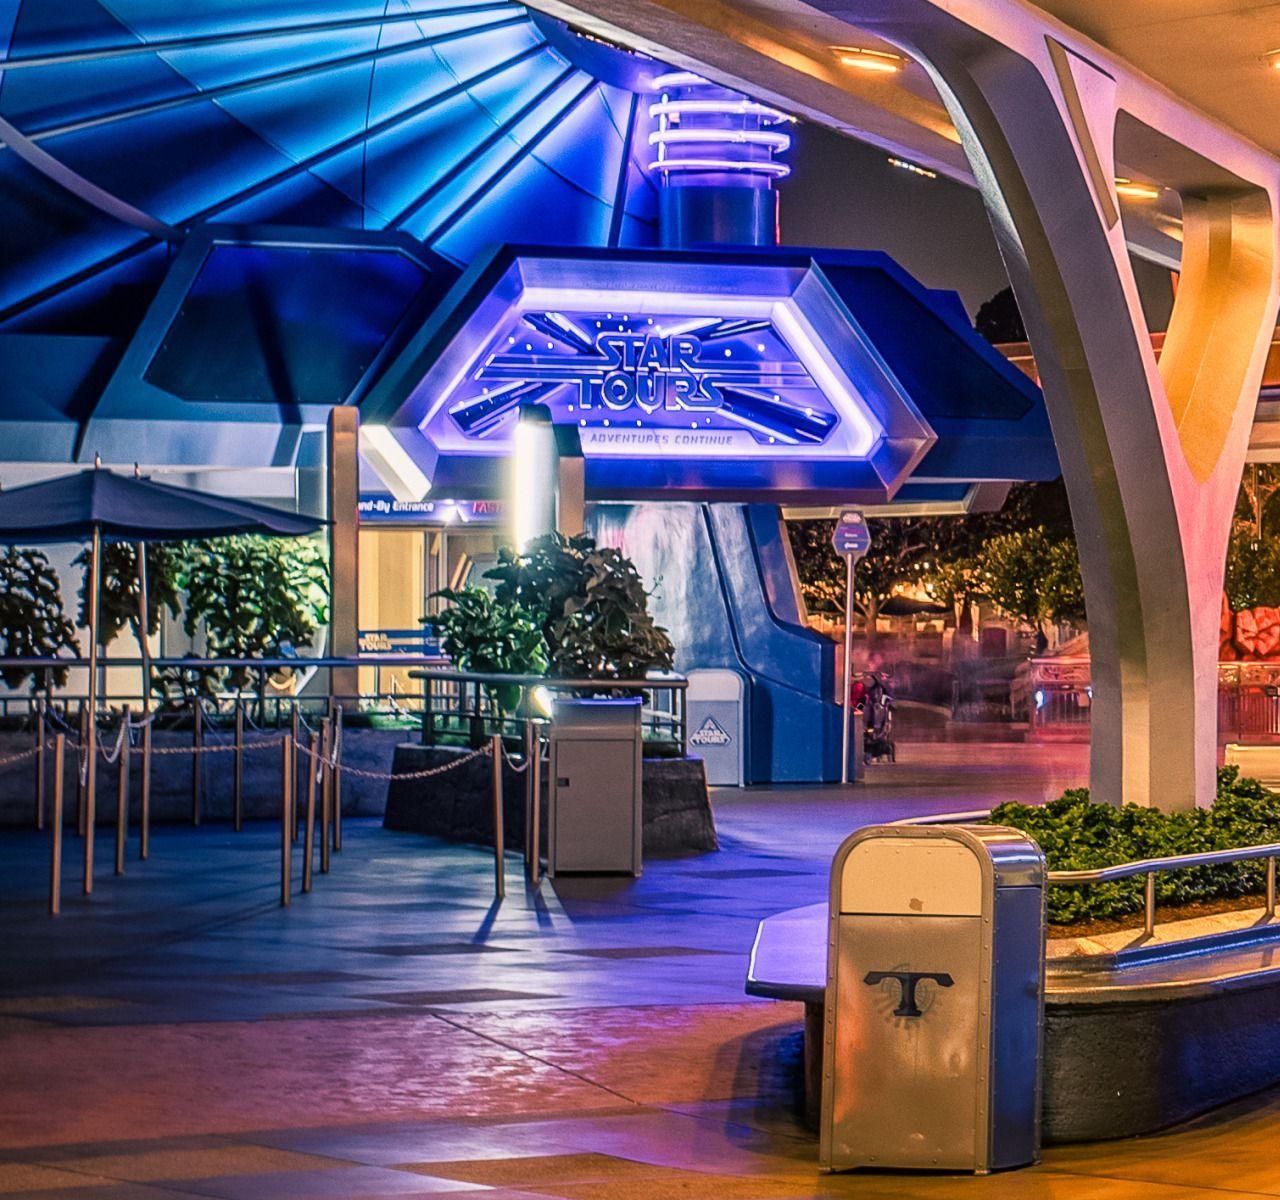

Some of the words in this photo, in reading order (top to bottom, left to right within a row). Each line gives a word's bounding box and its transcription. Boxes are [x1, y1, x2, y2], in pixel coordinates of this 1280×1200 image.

[594, 331, 702, 372] STAR
[576, 370, 724, 412] TOURS
[590, 432, 669, 445] ADVENTURES
[674, 434, 734, 446] CONTINUE
[393, 499, 434, 513] Entrance
